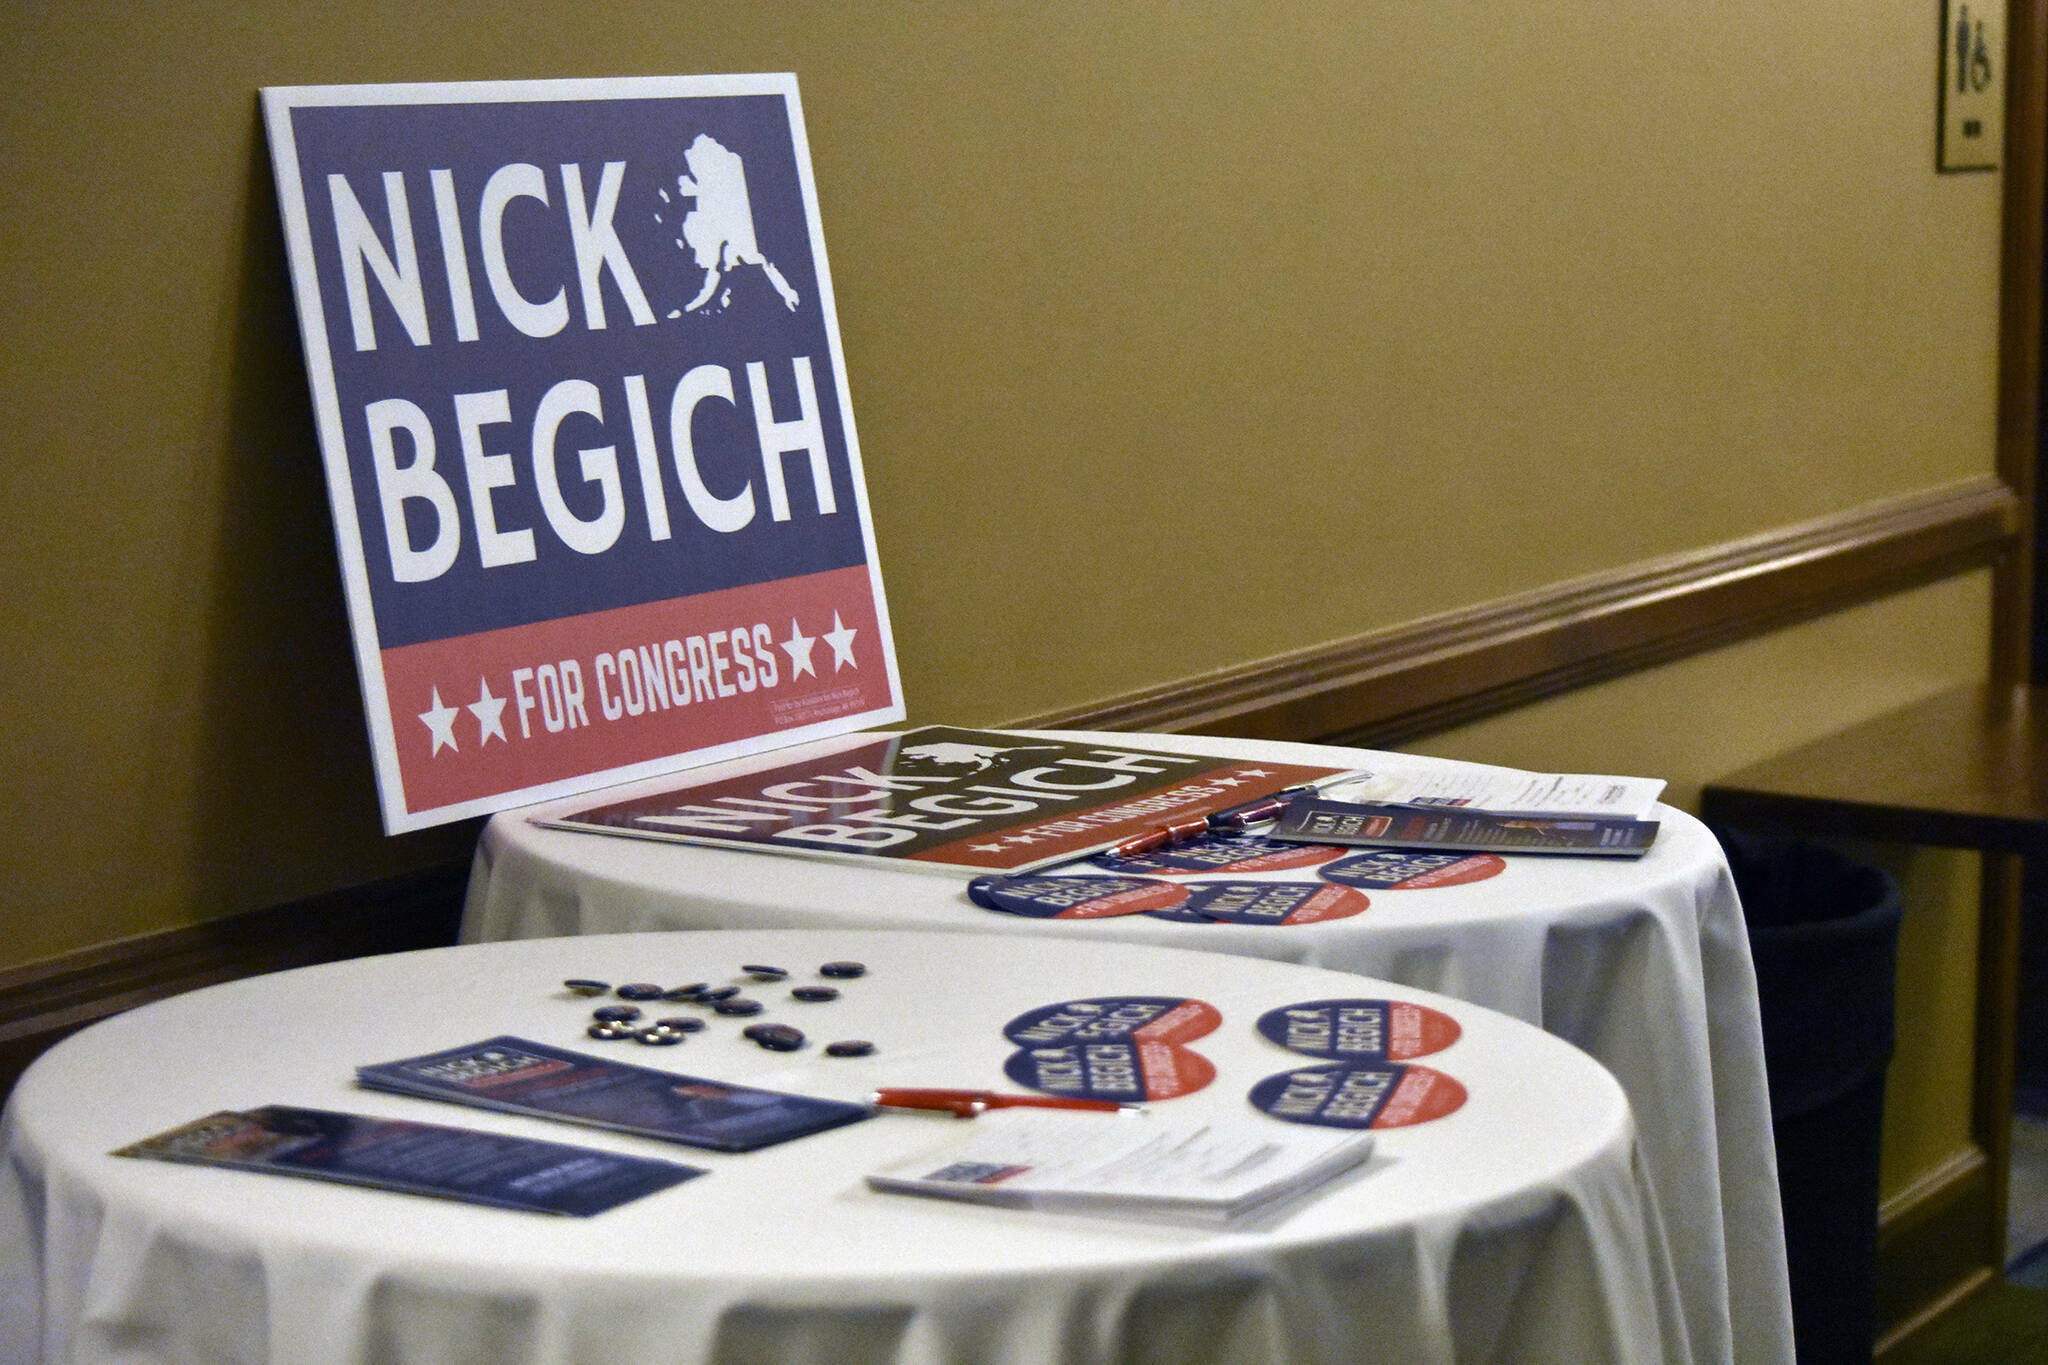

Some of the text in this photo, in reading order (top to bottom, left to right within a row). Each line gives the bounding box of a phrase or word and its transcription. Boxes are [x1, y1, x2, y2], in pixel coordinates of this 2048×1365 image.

[327, 161, 657, 352] NICK
[364, 356, 838, 583] BEGICH
[512, 623, 779, 739] FOR CONGRESS
[633, 765, 957, 832] NICK
[775, 750, 1200, 848] BEGICH
[1021, 785, 1226, 838] FOR CONGRESS
[1244, 886, 1314, 916] BEGICH
[1364, 854, 1461, 882] BEGICH
[1337, 1008, 1382, 1052] BEGICH
